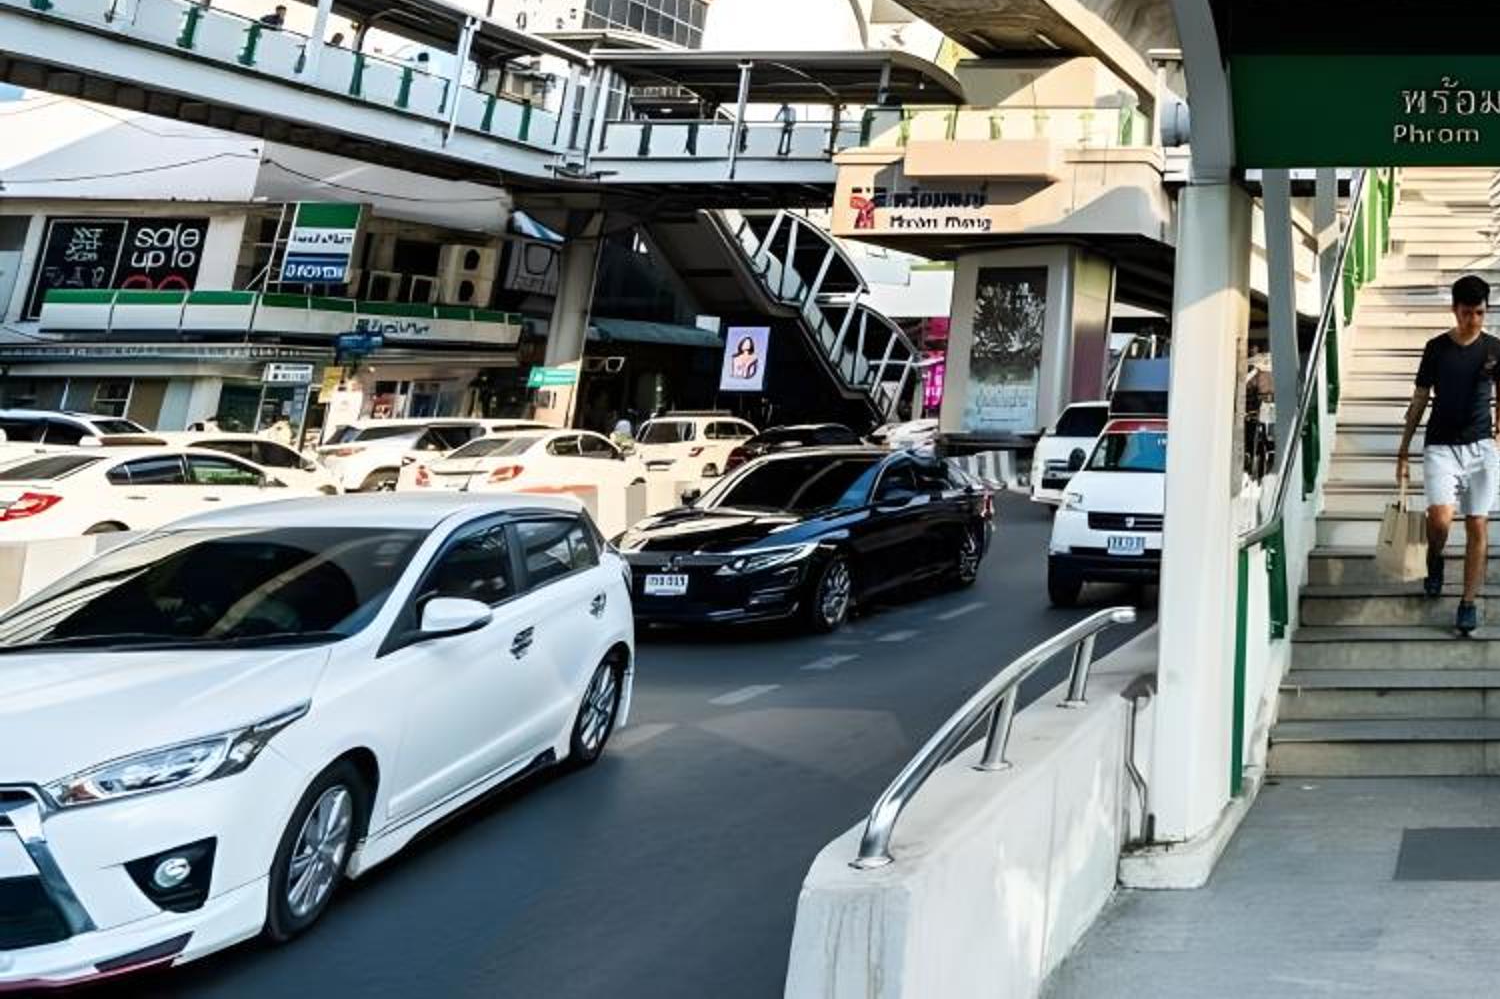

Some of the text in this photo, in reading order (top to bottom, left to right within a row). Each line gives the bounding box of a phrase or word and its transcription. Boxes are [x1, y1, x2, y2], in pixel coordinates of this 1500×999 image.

[1393, 124, 1480, 143] Phrom
[135, 222, 200, 248] sale
[131, 251, 165, 274] up
